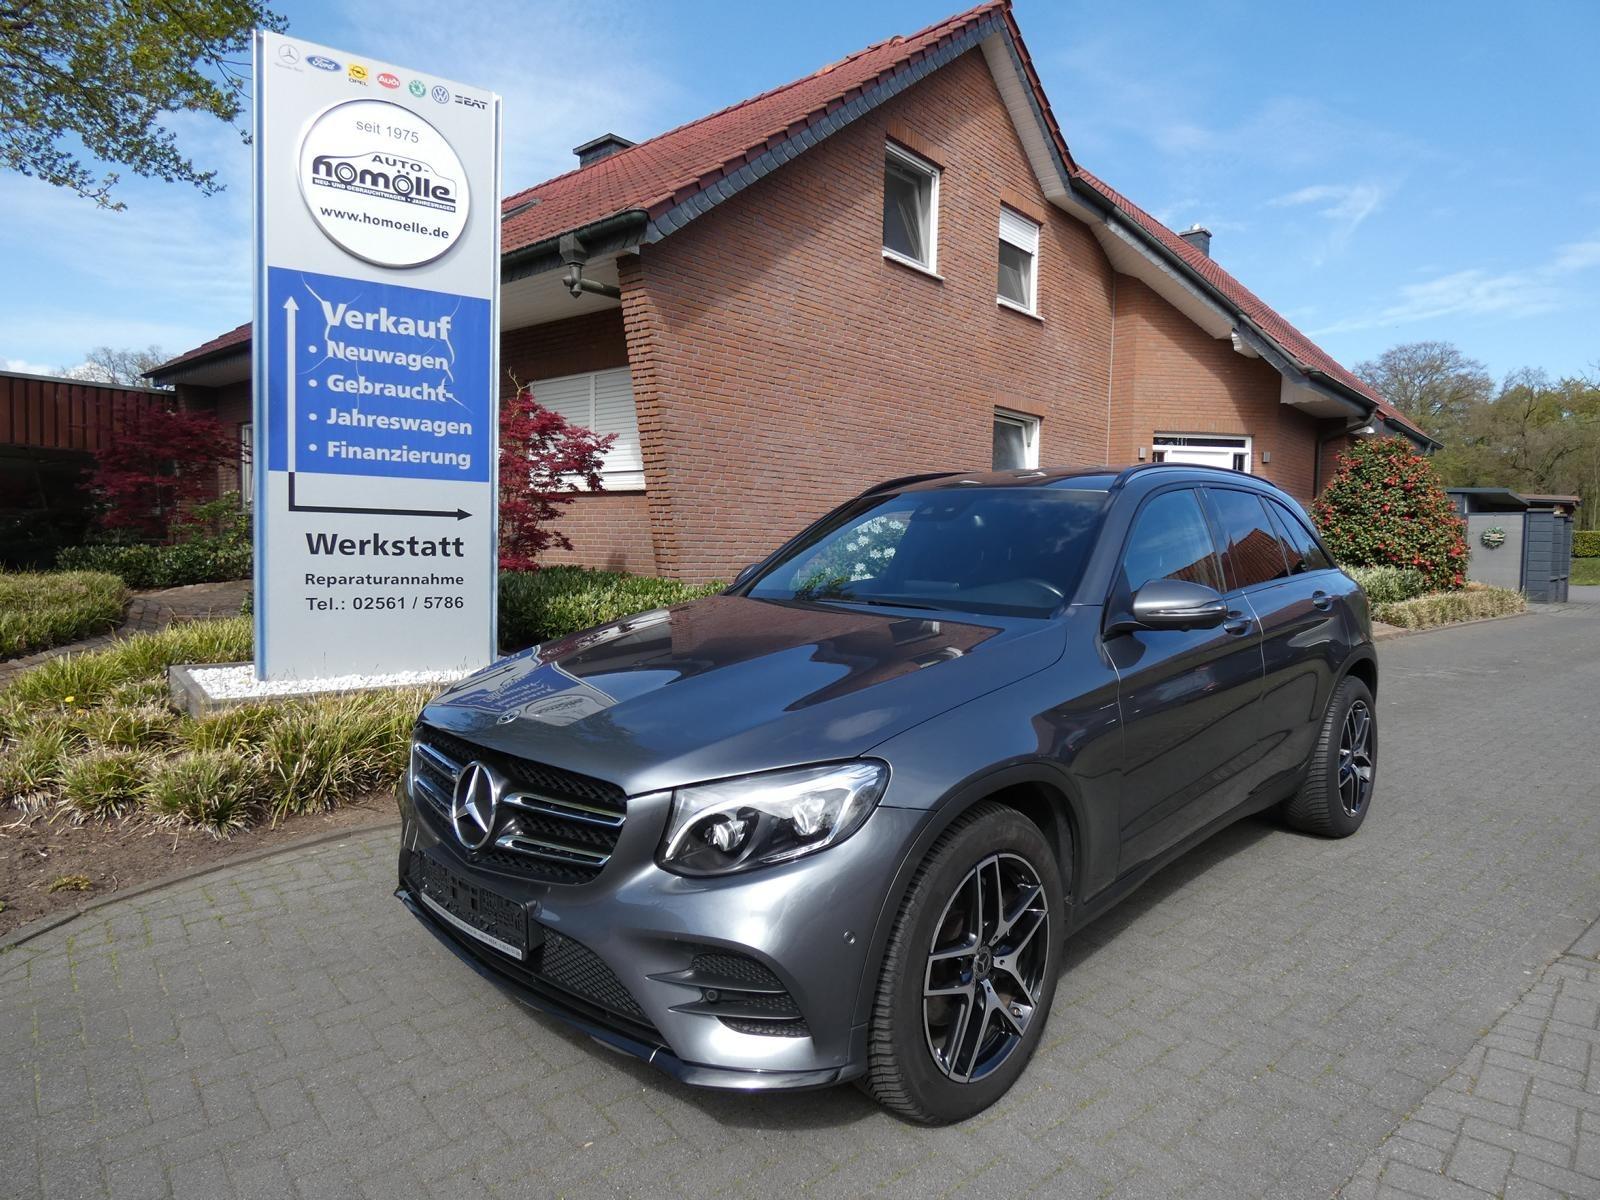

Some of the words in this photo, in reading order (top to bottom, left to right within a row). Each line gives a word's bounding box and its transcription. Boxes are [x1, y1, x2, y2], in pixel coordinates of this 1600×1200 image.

[311, 56, 338, 71] Ford
[348, 78, 368, 87] OPEL
[455, 94, 488, 110] SEAT
[356, 119, 380, 135] seit
[386, 125, 419, 144] 1975
[372, 154, 429, 172] AUTO-
[331, 181, 346, 190] UND
[347, 184, 406, 202] GEBRAUCHTWAGEN
[320, 206, 449, 239] www.homoelle.de
[322, 300, 452, 340] Verkauf
[327, 341, 448, 371] Neuwagen
[326, 408, 472, 437] Jahreswagen
[327, 441, 471, 469] Finanzierung
[305, 533, 464, 557] Werkstatt
[305, 573, 464, 588] Reparaturannahme
[306, 597, 345, 611] Tel.:
[352, 597, 405, 610] 02561
[423, 596, 464, 609] 5786
